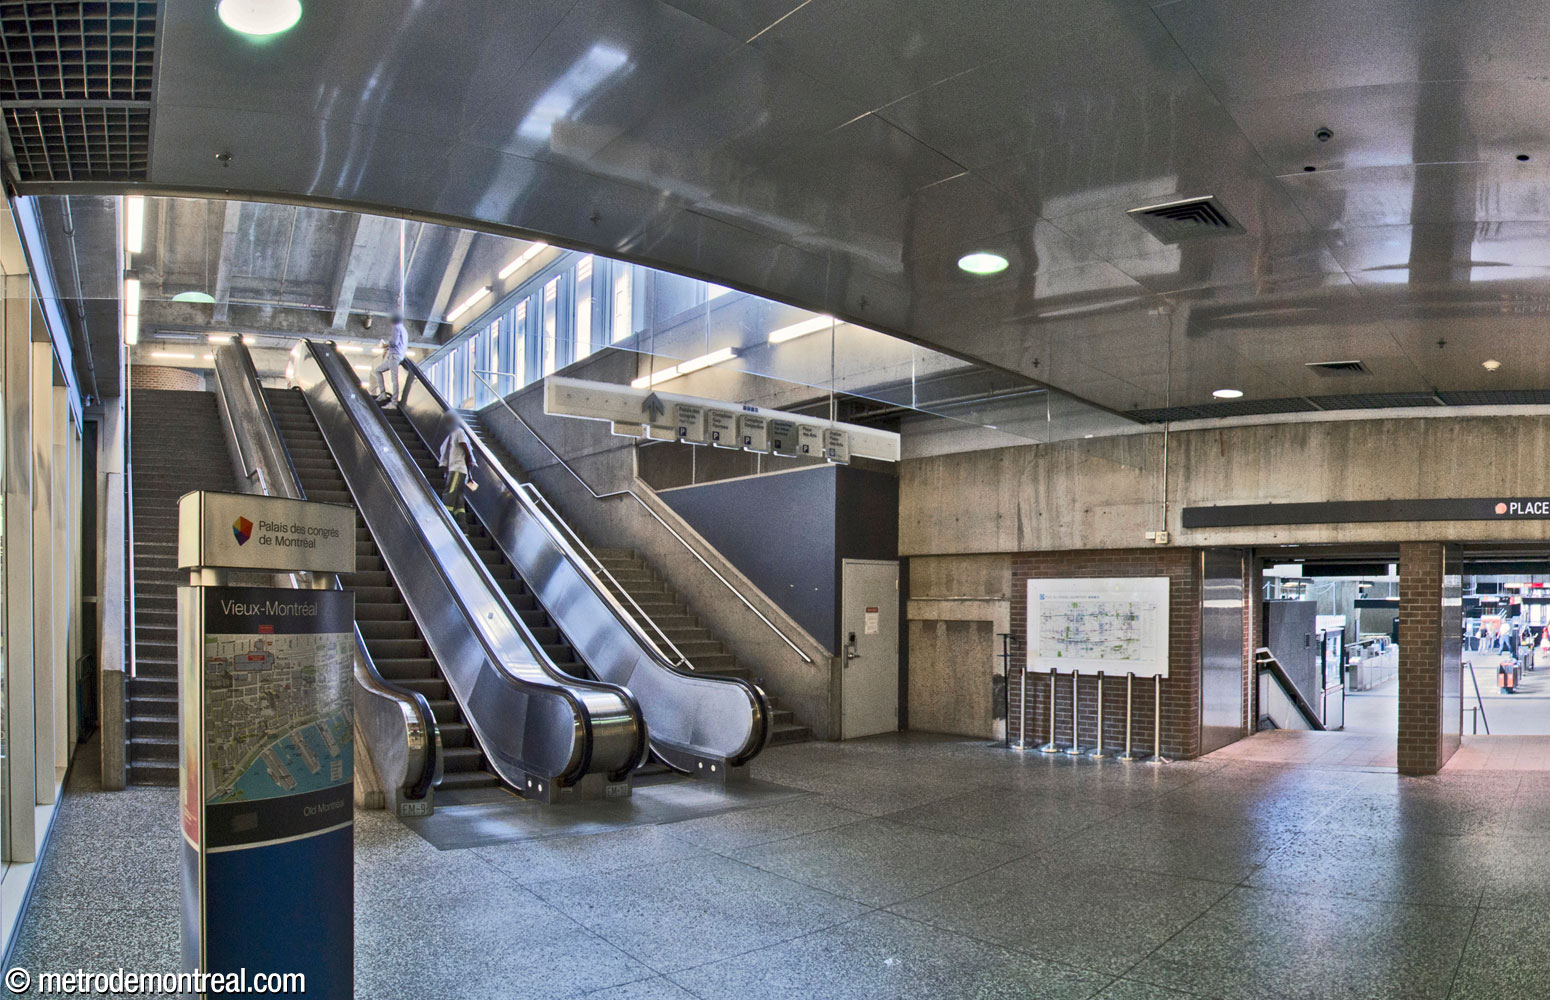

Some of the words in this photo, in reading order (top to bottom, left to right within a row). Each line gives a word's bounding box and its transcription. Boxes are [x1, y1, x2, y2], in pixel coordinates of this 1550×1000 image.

[259, 520, 288, 533] Palais
[289, 523, 306, 535] des
[307, 526, 339, 539] congrès
[258, 535, 272, 545] de
[275, 535, 316, 549] Montréal
[221, 599, 318, 616] Vieux-Montréal
[303, 806, 317, 816] Old
